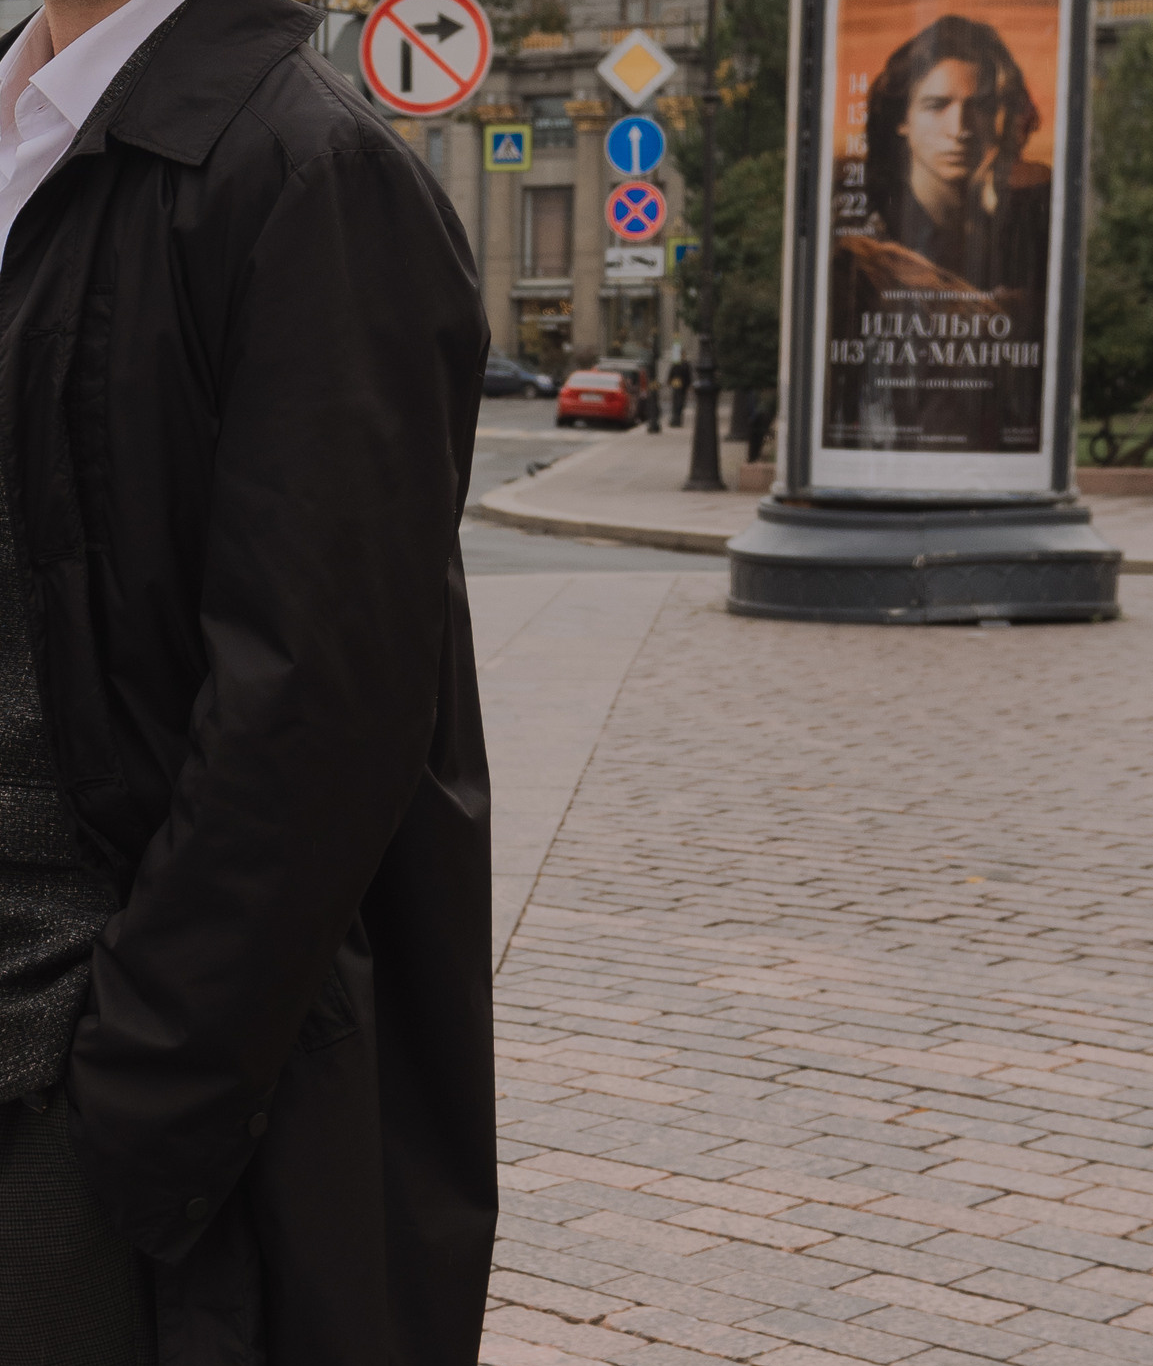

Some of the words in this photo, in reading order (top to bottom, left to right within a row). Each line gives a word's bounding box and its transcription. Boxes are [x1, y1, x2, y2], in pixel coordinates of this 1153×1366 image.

[848, 102, 867, 124] 15
[846, 133, 867, 156] 16
[843, 163, 864, 186] 21
[839, 193, 866, 217] 22
[861, 312, 1011, 338] ИДАЛЬГО
[831, 340, 864, 365] ИЗ
